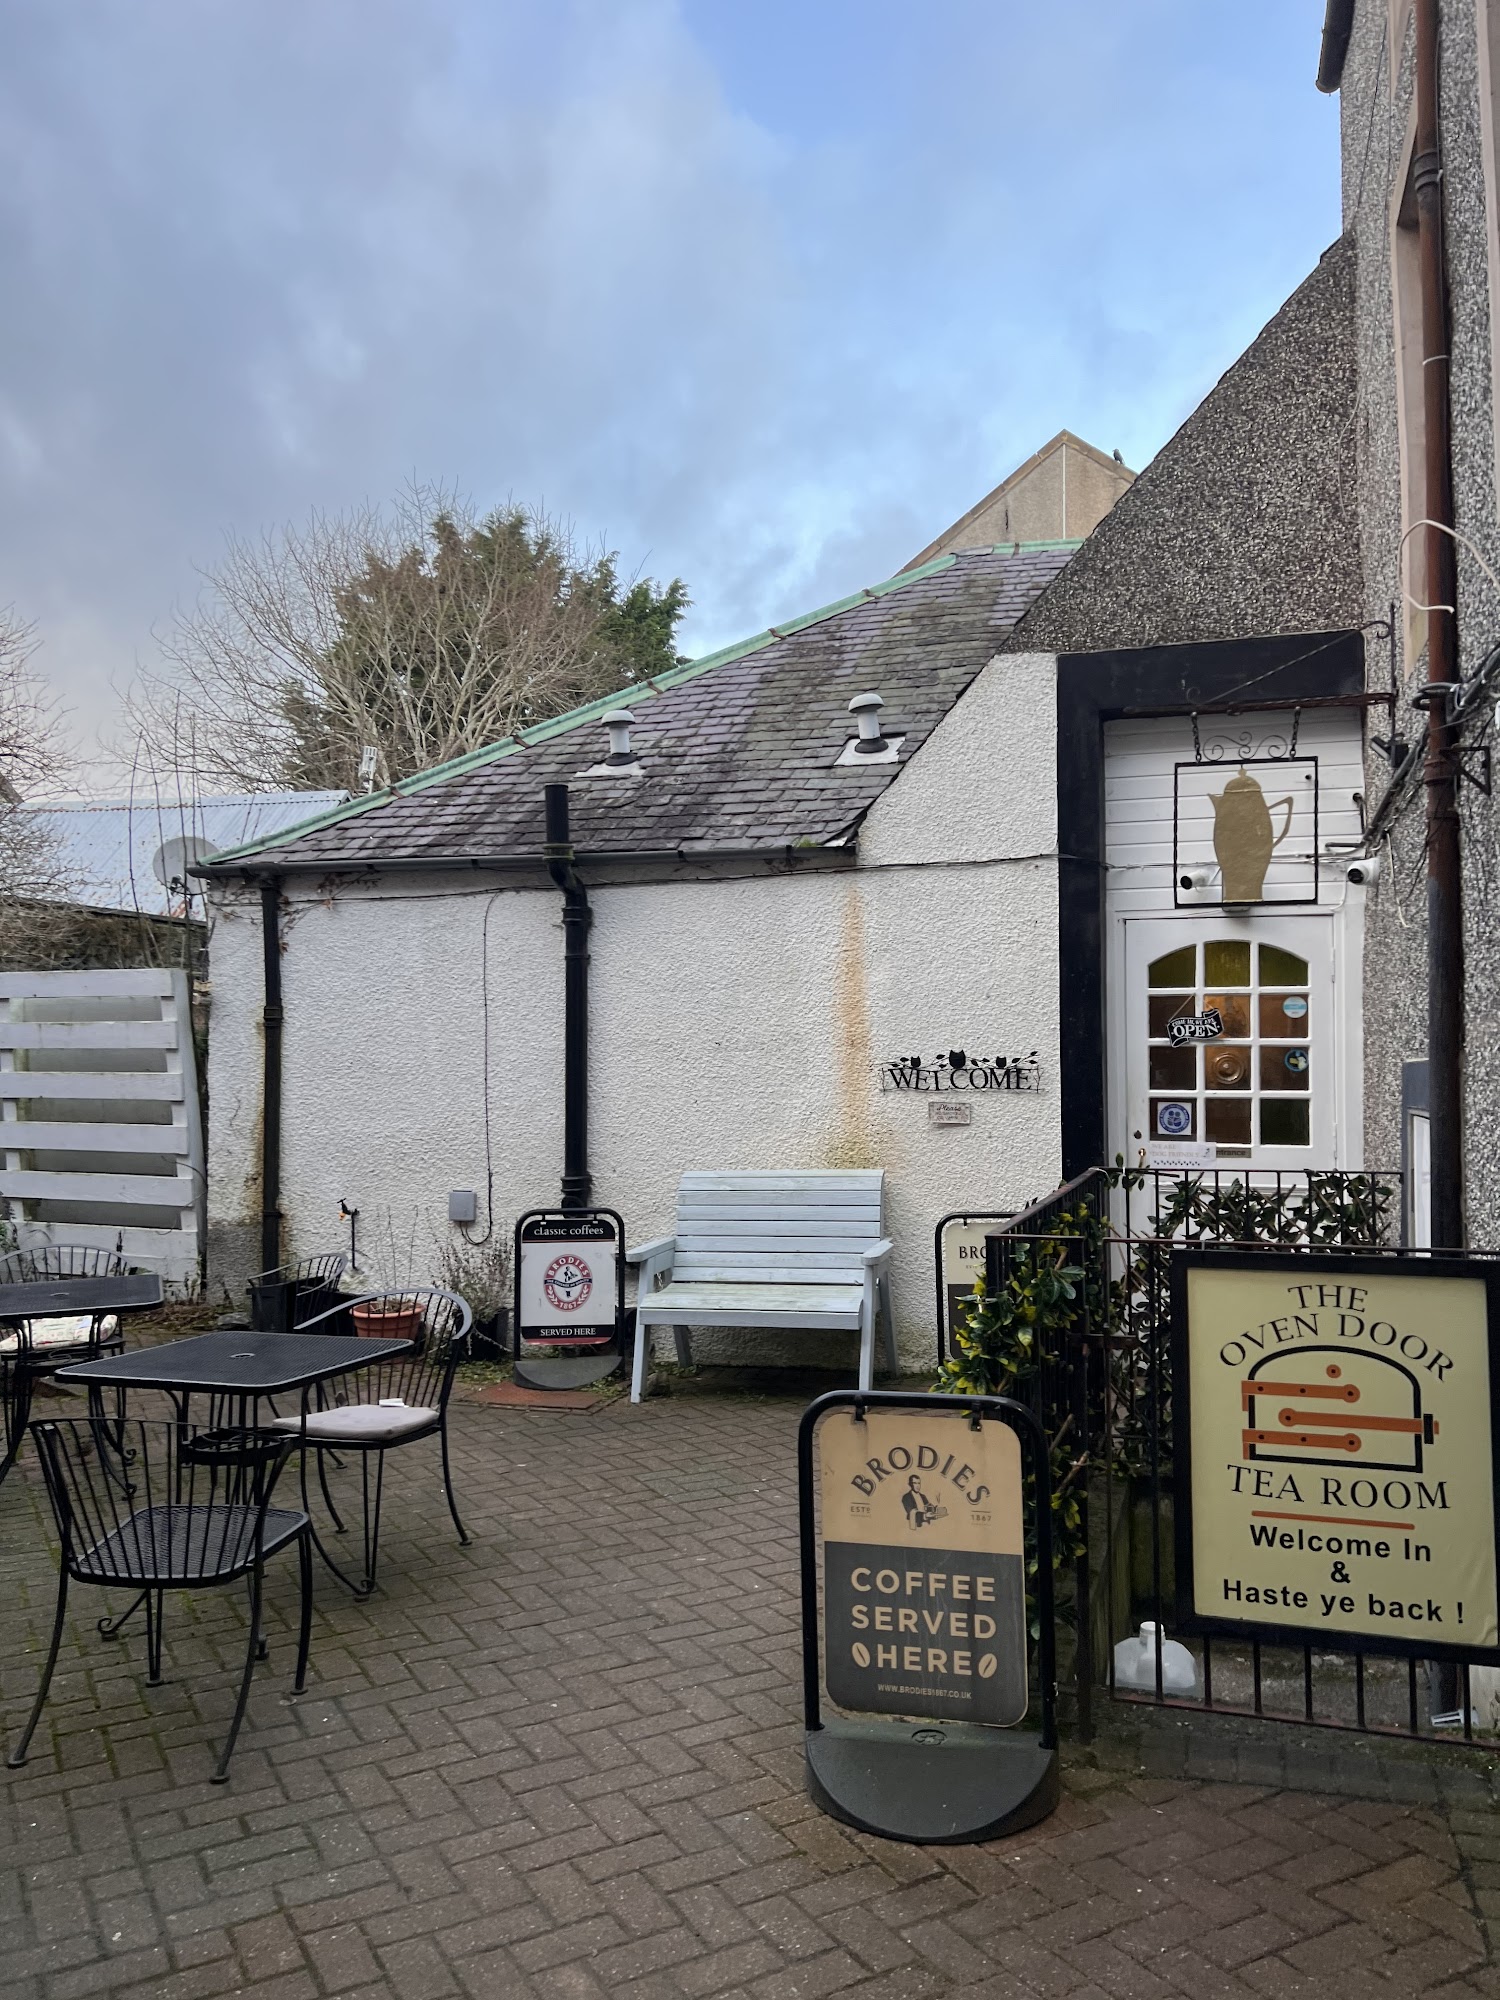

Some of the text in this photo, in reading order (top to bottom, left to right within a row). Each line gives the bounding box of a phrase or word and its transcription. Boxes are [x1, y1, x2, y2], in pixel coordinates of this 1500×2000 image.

[1173, 1021, 1219, 1038] OPEN
[888, 1068, 1032, 1092] WELCOME
[534, 1224, 604, 1236] classic coffees
[548, 1256, 589, 1276] BRODIES
[560, 1301, 577, 1310] 1867
[1288, 1284, 1369, 1314] THE
[540, 1327, 596, 1336] SERVED HERE
[1219, 1313, 1455, 1383] OVEN DOOR
[851, 1445, 991, 1507] BRODIES
[1227, 1464, 1451, 1510] TEA ROOM
[970, 1514, 992, 1523] 1867
[1250, 1524, 1432, 1562] Welcome In
[851, 1567, 996, 1602] COFFEE
[1330, 1561, 1351, 1584] &
[1223, 1579, 1309, 1608] Haste
[1320, 1595, 1355, 1617] ye
[1368, 1593, 1443, 1624] back
[851, 1604, 997, 1640] SERVED
[877, 1643, 972, 1676] HERE
[877, 1683, 972, 1700] WWW.BRODIES1867.CO.UK
